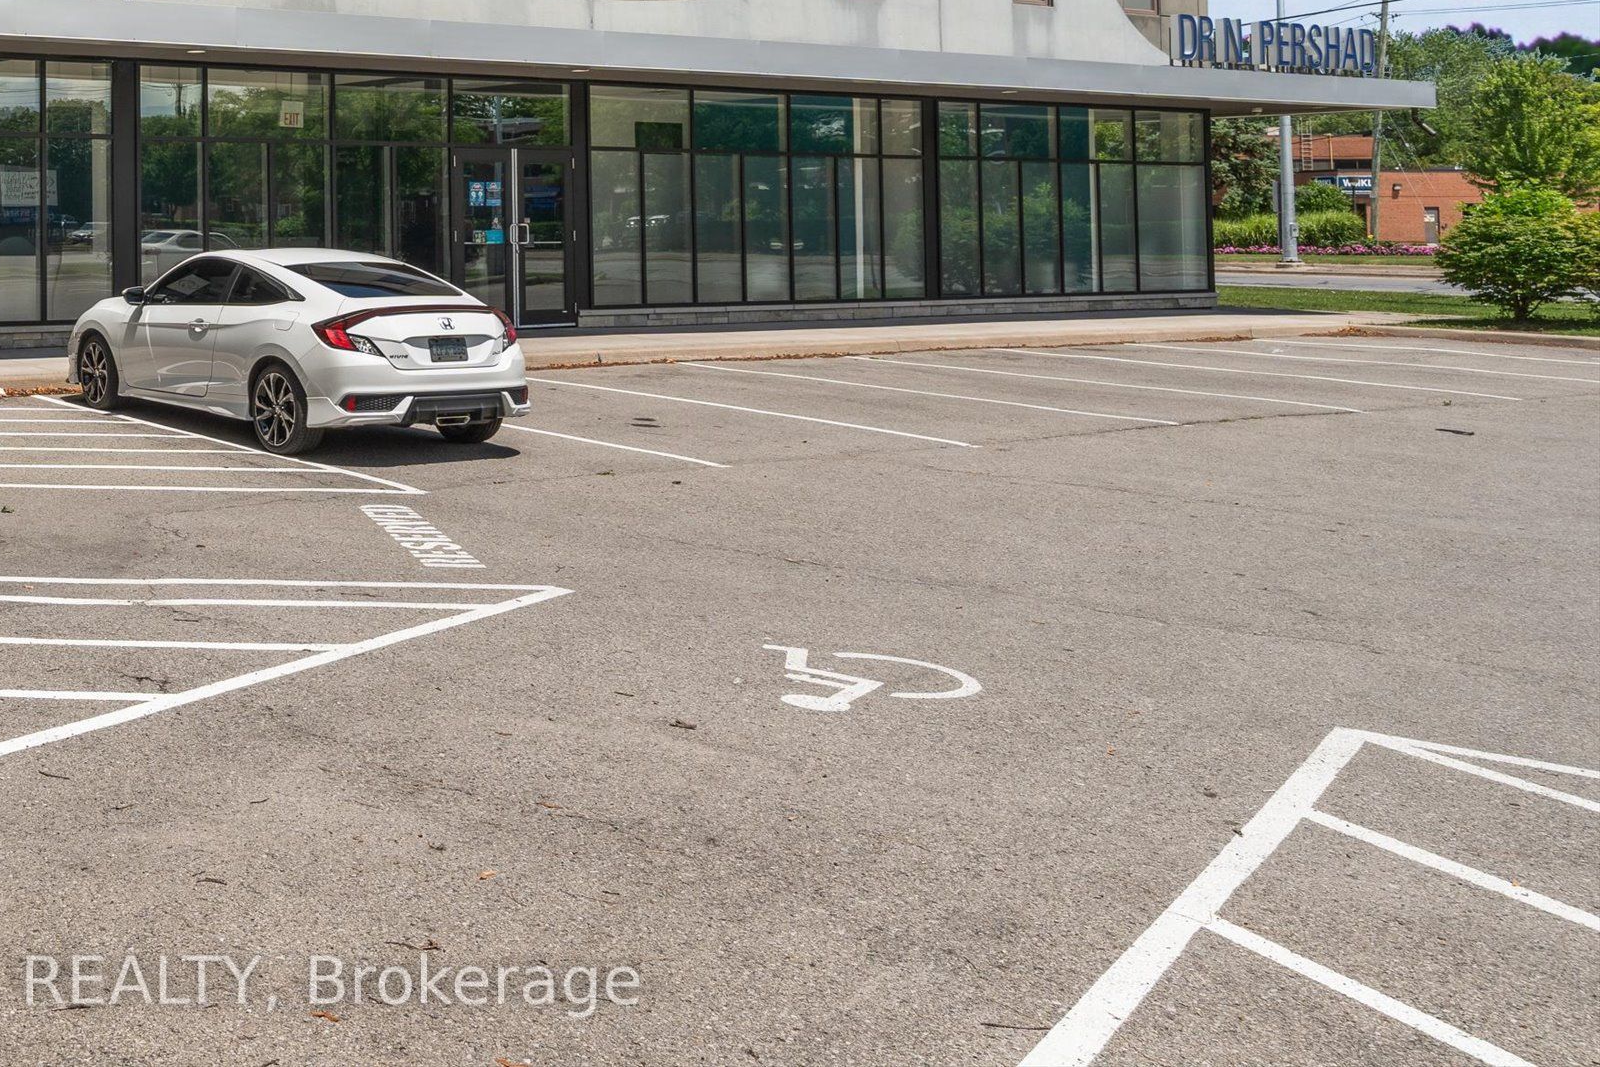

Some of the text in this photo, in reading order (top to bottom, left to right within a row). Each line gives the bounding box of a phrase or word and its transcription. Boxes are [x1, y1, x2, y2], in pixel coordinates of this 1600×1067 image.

[1257, 20, 1376, 72] PERSHAD
[284, 112, 300, 125] EXIT
[359, 504, 487, 569] RESERVED
